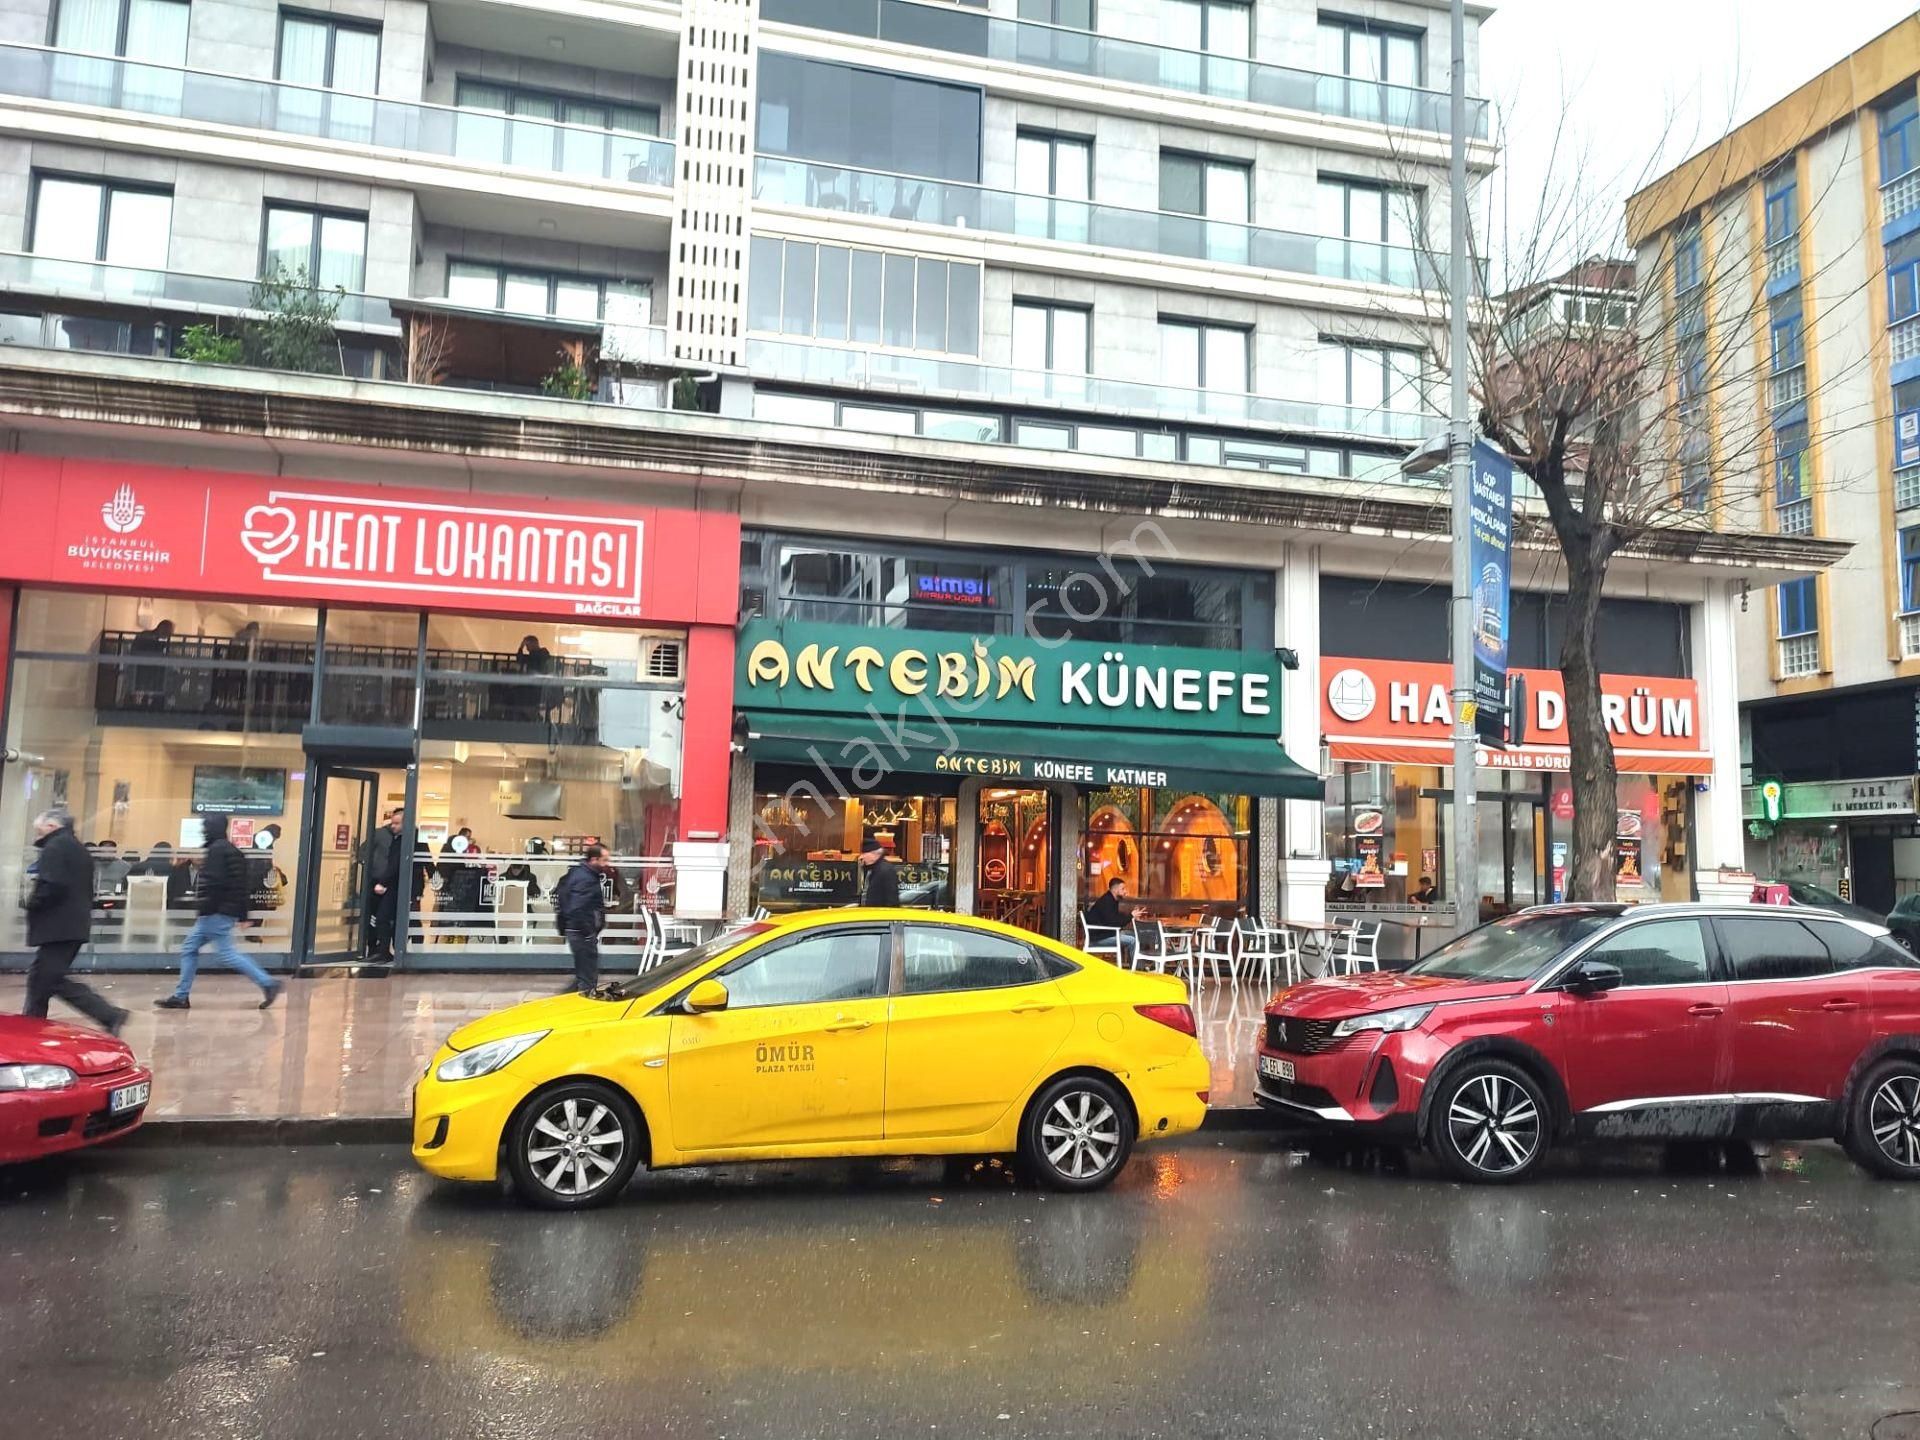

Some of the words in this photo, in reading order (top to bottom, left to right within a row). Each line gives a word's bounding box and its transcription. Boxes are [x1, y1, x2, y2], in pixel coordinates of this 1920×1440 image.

[67, 545, 170, 563] BÜYÜKŞEHİR
[304, 509, 403, 574] KENT
[414, 517, 627, 589] LOKANTASI
[575, 601, 641, 617] BAĞCILAR
[748, 638, 1036, 702] ANTEBİM
[1062, 651, 1271, 715] KÜNEFE
[1538, 688, 1693, 737] DRÜM
[1493, 753, 1532, 767] HALİS
[1535, 754, 1571, 768] DÜRÜ
[1035, 761, 1093, 781] KÜNEFE
[1107, 768, 1167, 787] KATMER
[1852, 786, 1886, 798] PARK
[756, 1041, 815, 1063] ÖMÜR
[756, 1065, 785, 1073] PLAZA
